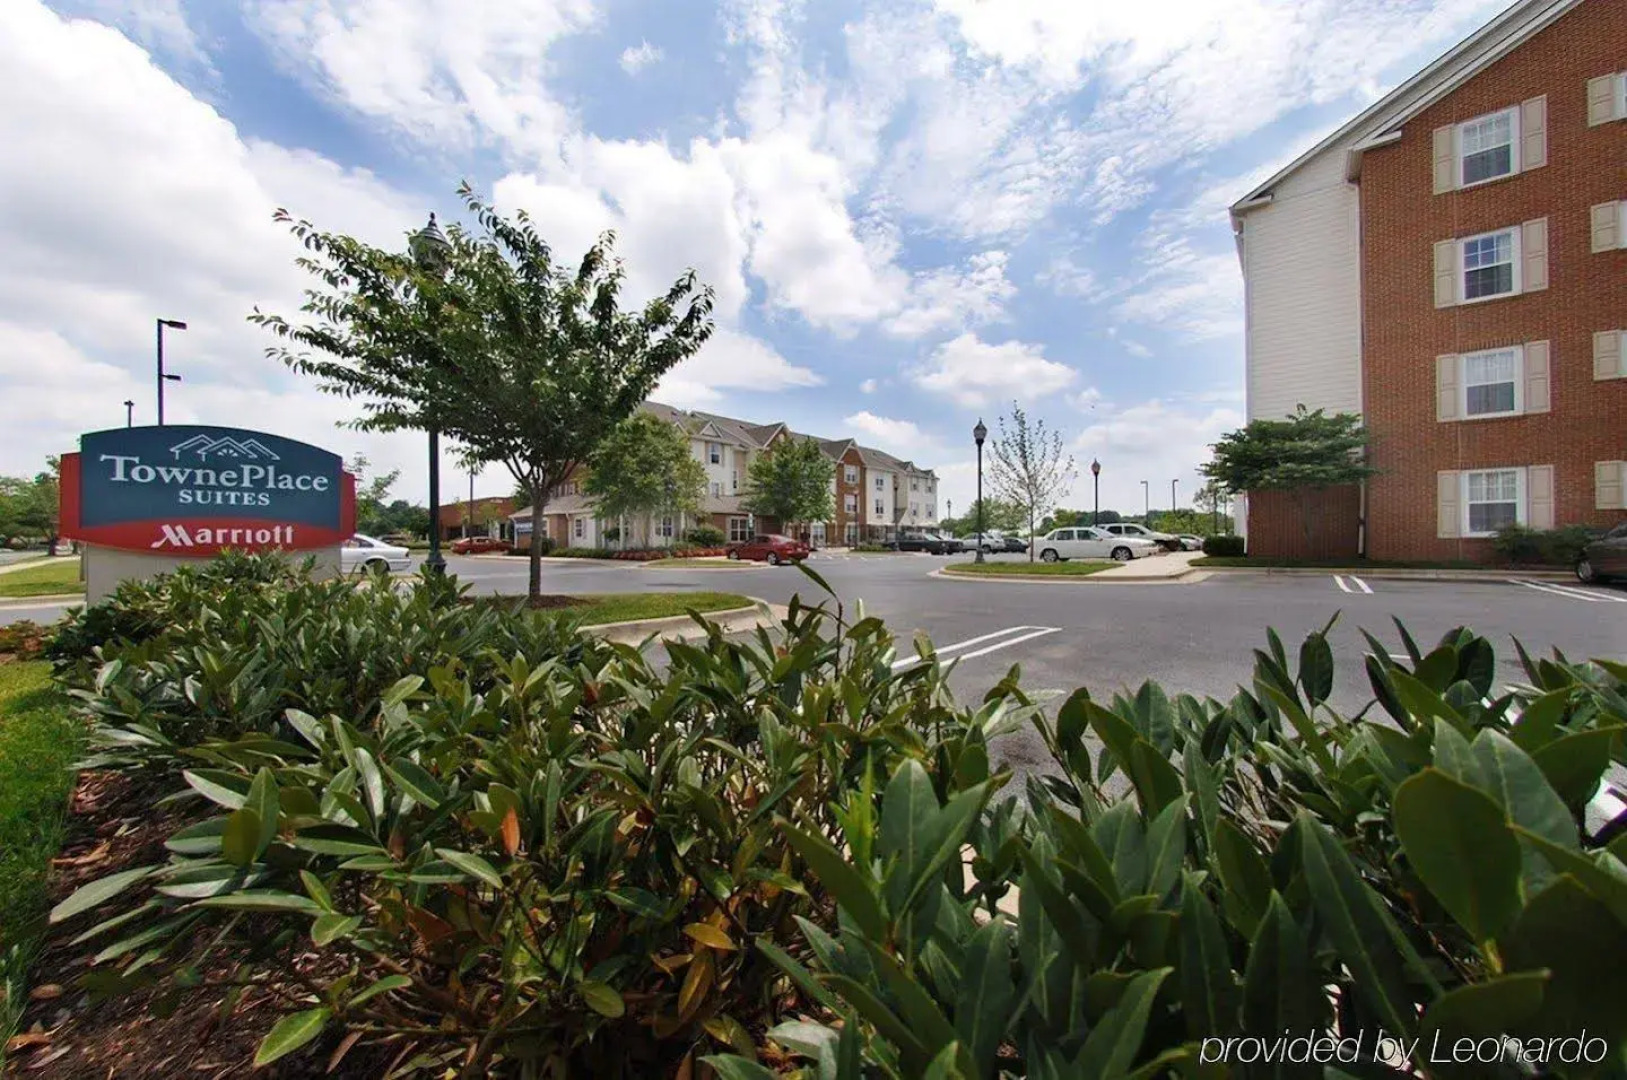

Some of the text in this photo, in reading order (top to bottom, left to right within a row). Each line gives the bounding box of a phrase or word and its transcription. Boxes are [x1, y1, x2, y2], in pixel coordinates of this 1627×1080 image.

[100, 454, 329, 491] TownePlace
[179, 489, 270, 506] SUITES
[151, 524, 294, 548] Marriott
